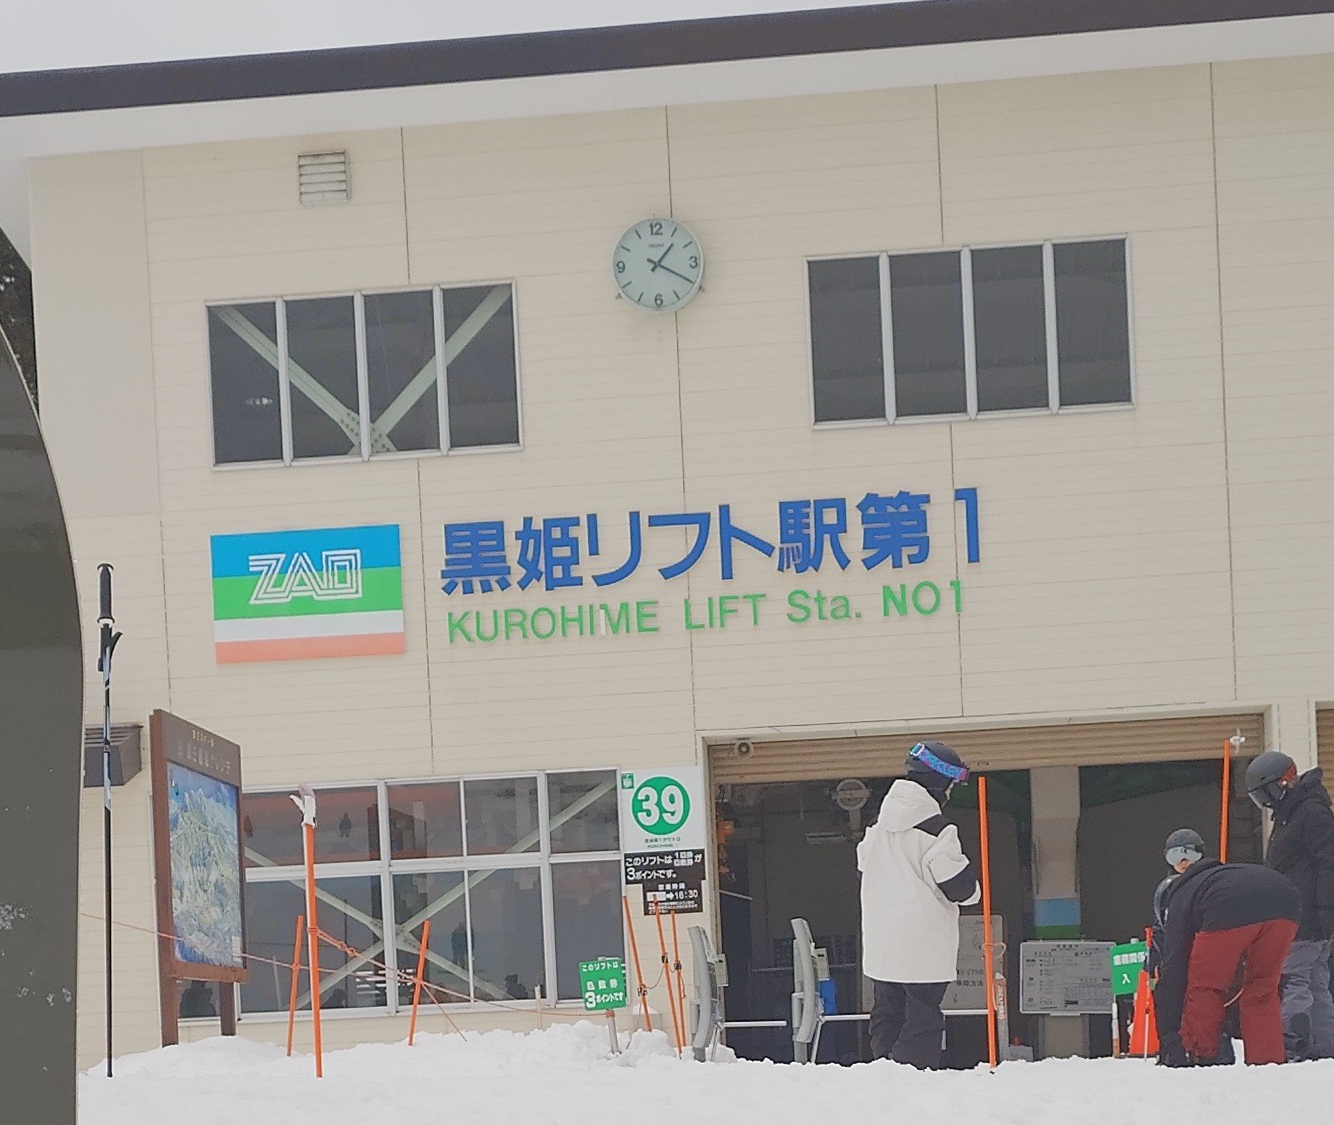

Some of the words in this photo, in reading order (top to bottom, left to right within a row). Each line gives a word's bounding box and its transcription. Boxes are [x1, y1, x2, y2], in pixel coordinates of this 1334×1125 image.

[649, 222, 663, 236] 12
[616, 260, 626, 274] 9
[689, 256, 699, 269] 3
[654, 293, 664, 307] 6
[440, 487, 980, 596] 黒姫リフト駅第1
[248, 549, 363, 605] ZAO
[447, 600, 660, 643] KUROHIME
[683, 593, 766, 631] LIFT
[786, 589, 862, 624] Sta.
[637, 784, 684, 826] 39
[625, 855, 673, 866] このリフトは
[581, 962, 619, 972] このリフトは
